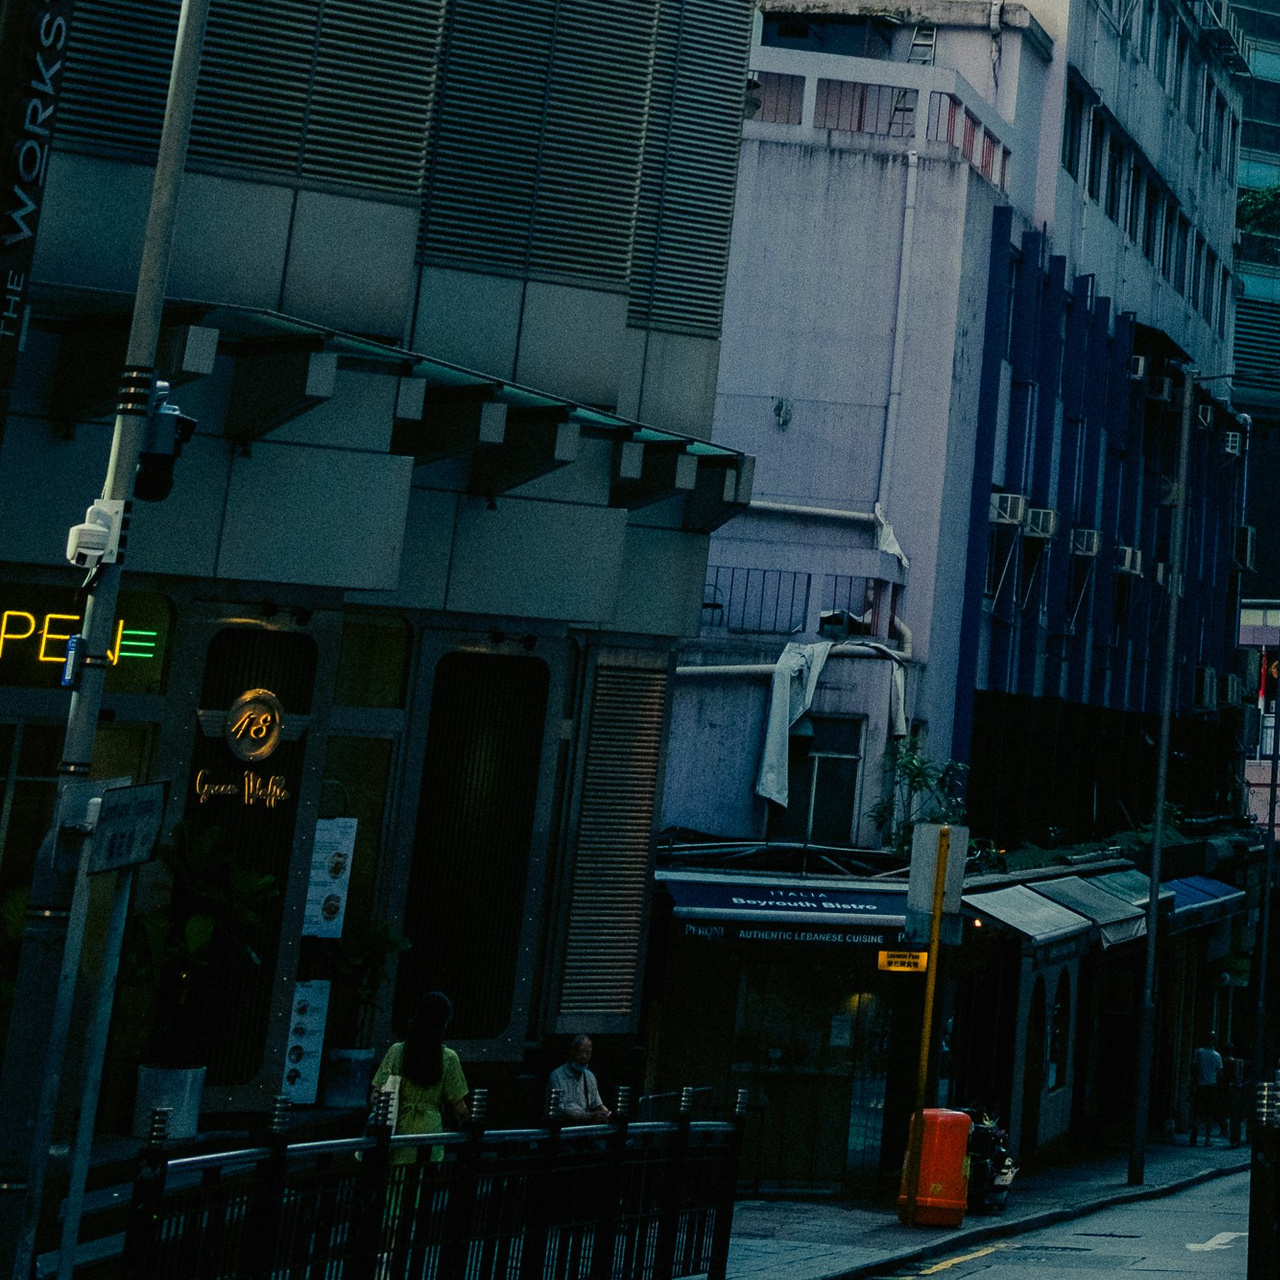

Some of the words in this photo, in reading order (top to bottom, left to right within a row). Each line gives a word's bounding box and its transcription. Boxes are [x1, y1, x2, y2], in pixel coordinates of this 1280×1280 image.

[770, 890, 828, 899] ITALIA
[732, 897, 818, 909] Beyrouth
[821, 901, 878, 911] Bistro
[738, 929, 792, 940] AUTHENTIC
[794, 931, 844, 942] LEBANESE
[846, 933, 884, 944] CUISINE
